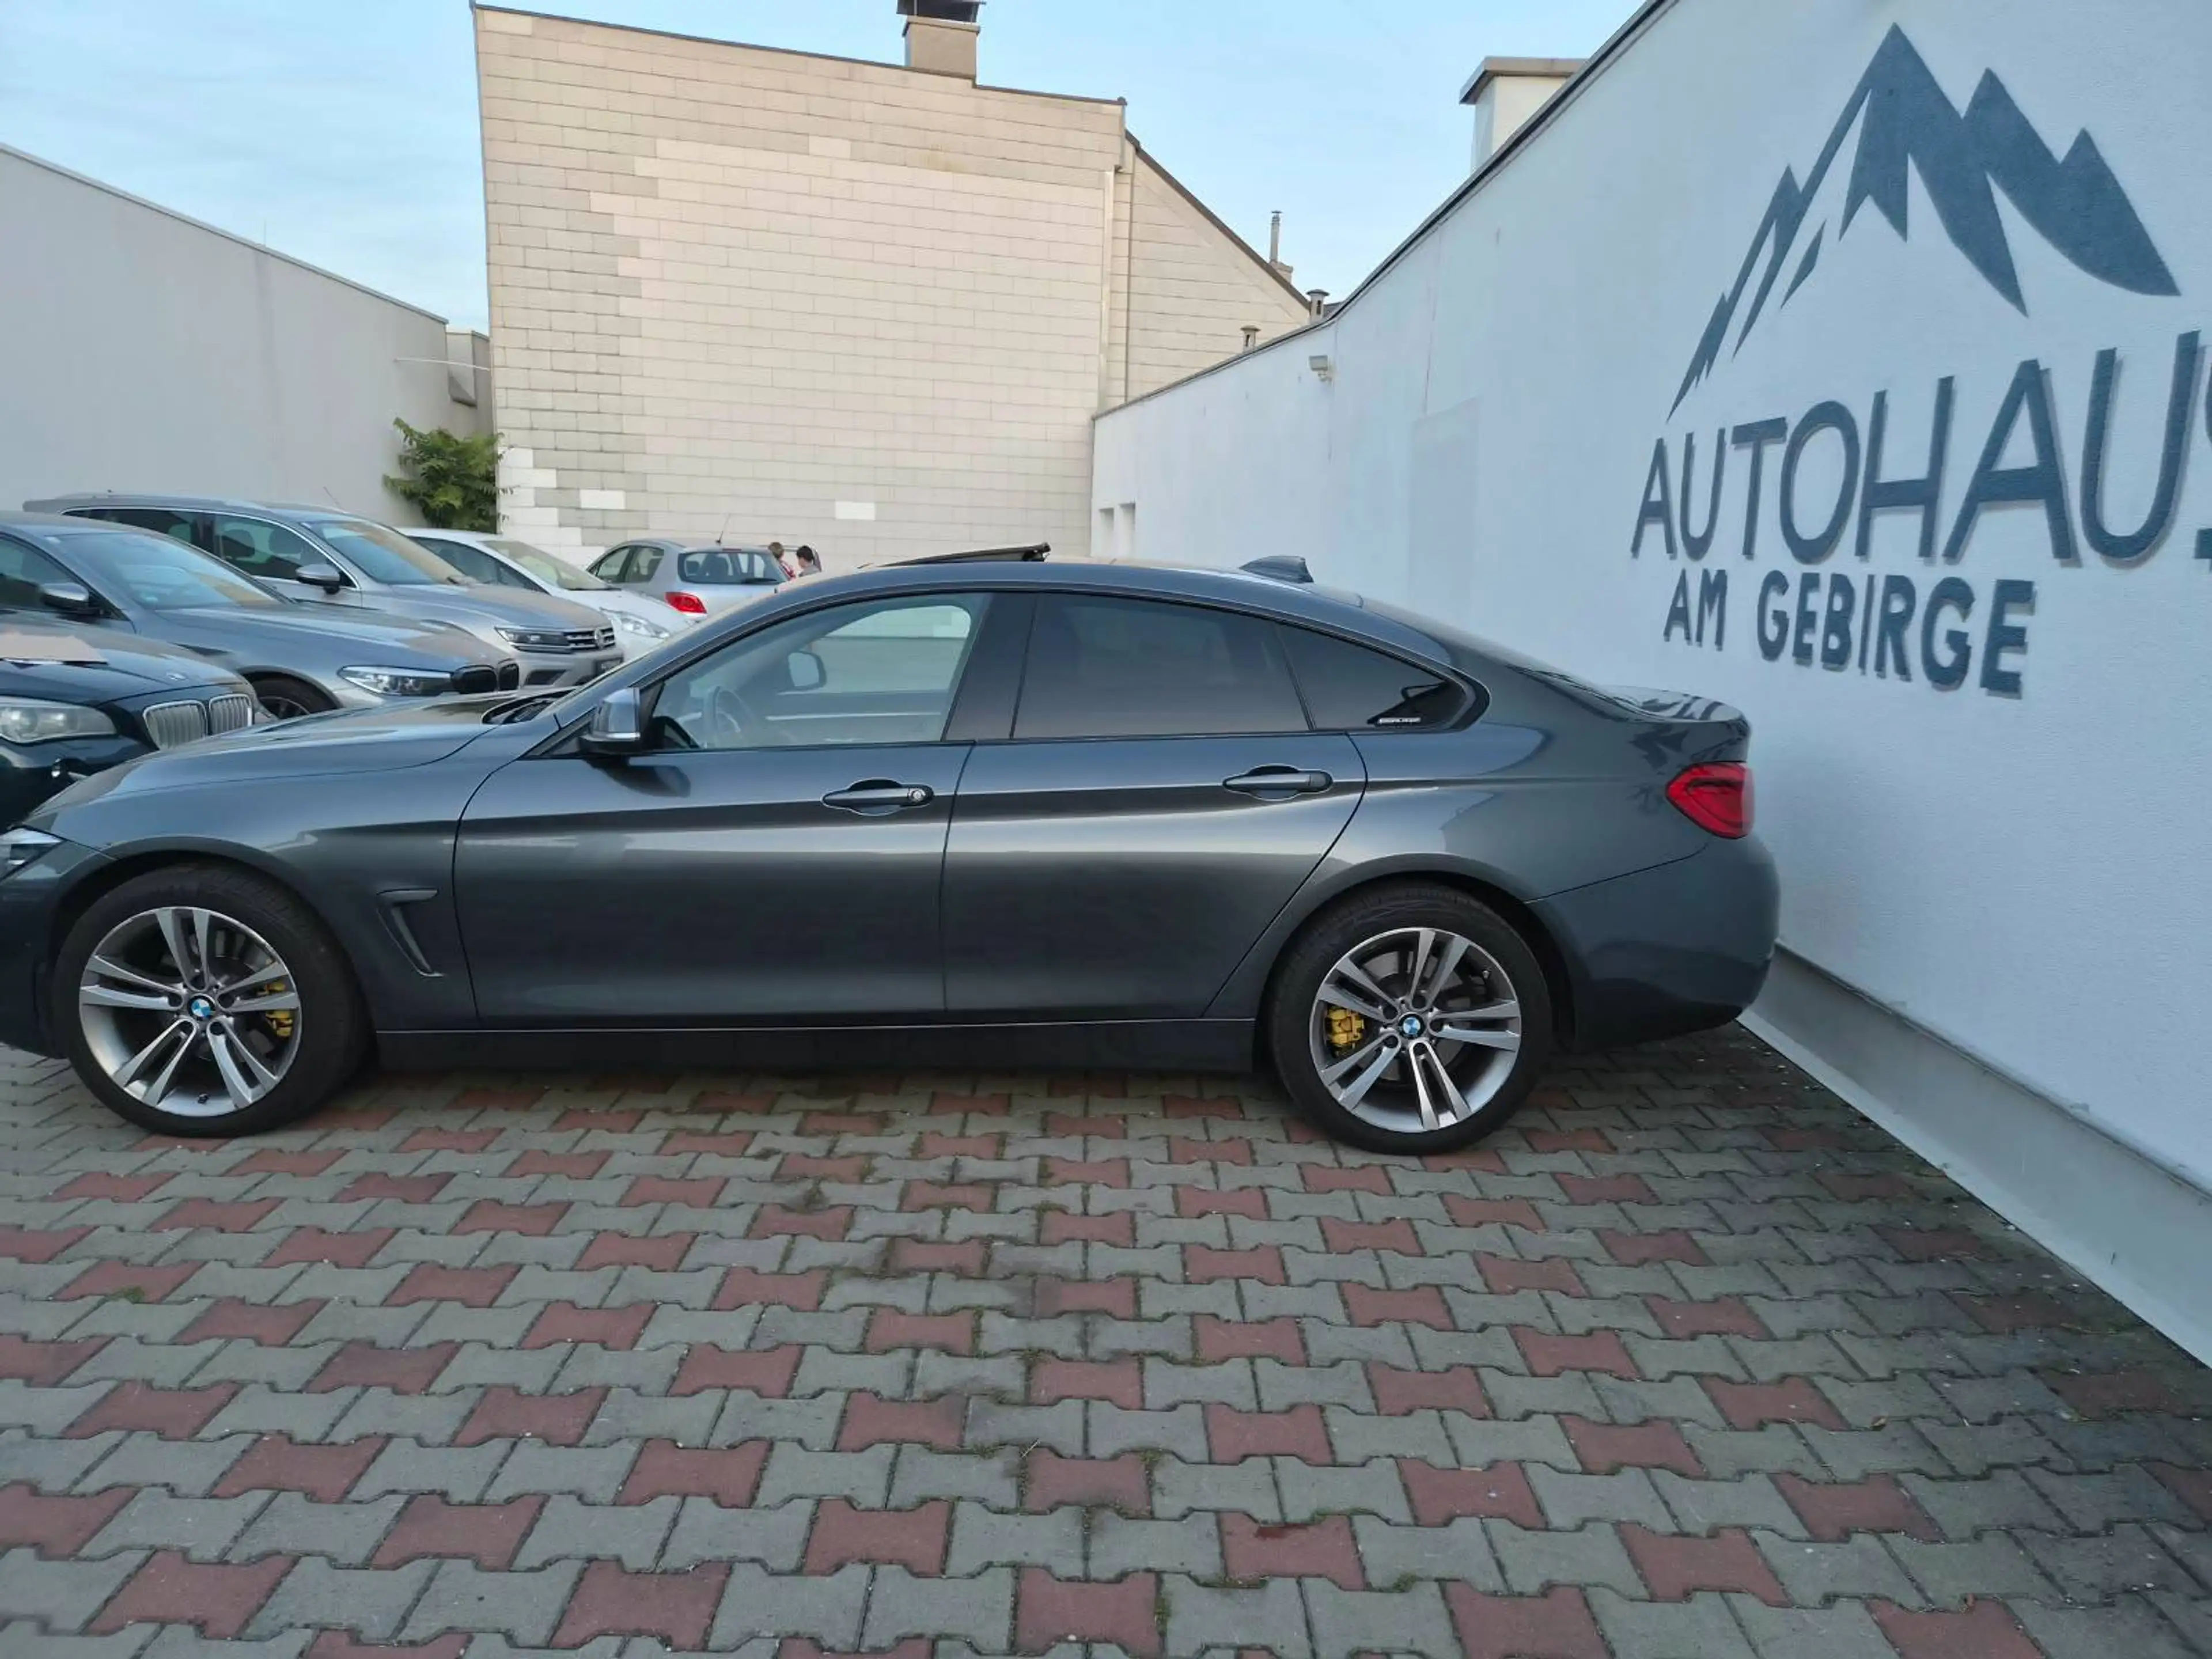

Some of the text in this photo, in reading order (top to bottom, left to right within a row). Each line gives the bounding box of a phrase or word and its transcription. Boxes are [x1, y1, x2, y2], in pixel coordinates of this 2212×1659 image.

[1631, 329, 2212, 565] AUTOHAU
[1663, 568, 2035, 695] AM GEBIRGE
